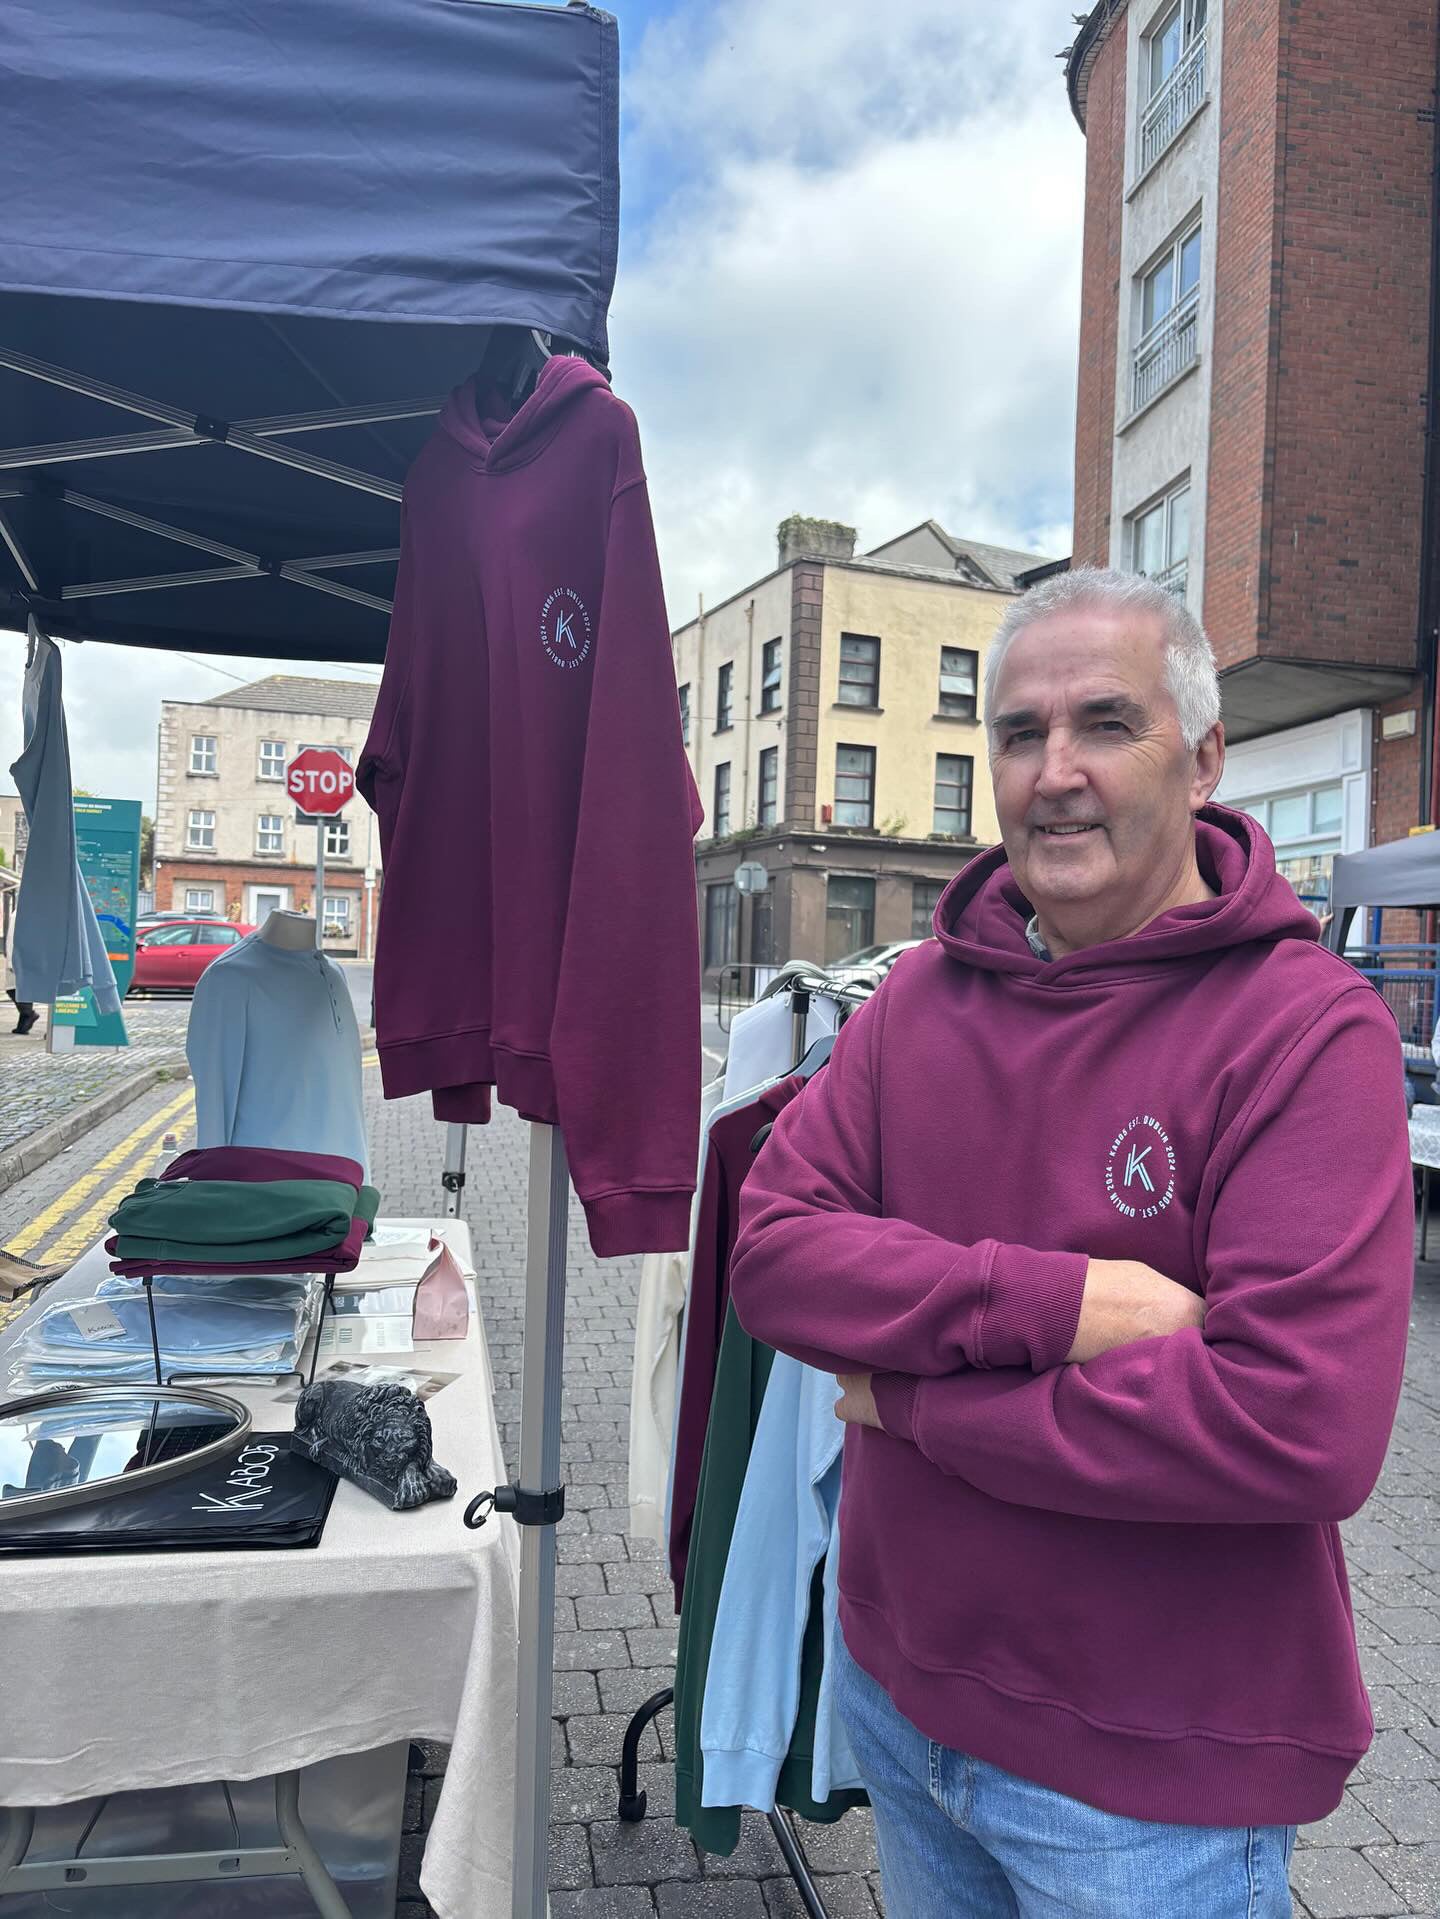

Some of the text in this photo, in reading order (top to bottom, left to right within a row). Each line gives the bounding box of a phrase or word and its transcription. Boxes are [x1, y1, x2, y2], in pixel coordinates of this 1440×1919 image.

[566, 588, 585, 610] DUBLIN
[555, 609, 577, 649] K
[289, 769, 353, 794] STOP
[1143, 1115, 1169, 1144] DUBLIN
[1165, 1145, 1176, 1171] 2024
[1104, 1166, 1115, 1191] 2024
[1123, 1143, 1155, 1192] K
[1109, 1192, 1135, 1218] DUBLIN
[1138, 1205, 1159, 1218] EST.
